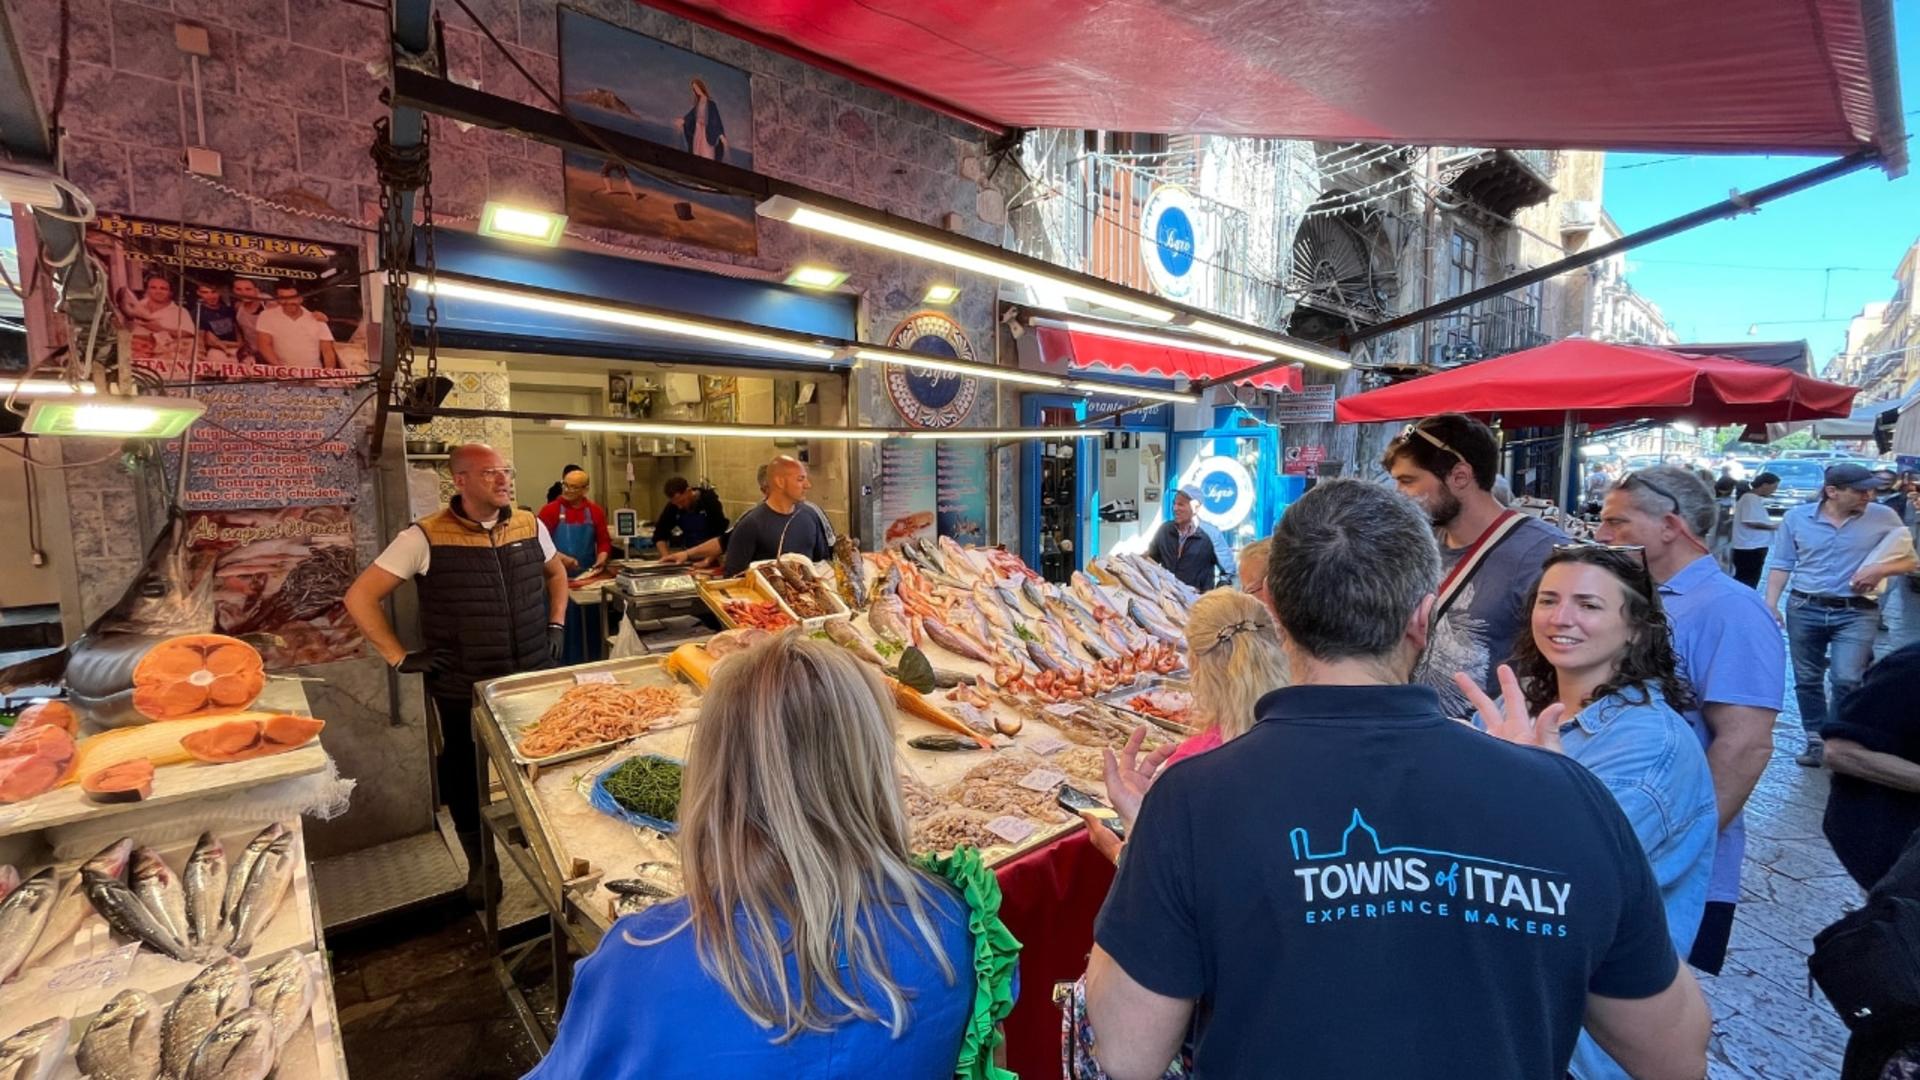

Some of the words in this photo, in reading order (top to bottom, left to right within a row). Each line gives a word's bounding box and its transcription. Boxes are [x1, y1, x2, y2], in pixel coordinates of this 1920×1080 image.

[101, 216, 328, 258] PESCHERIA
[252, 264, 318, 280] MIMMO
[221, 363, 247, 378] HA
[250, 429, 322, 441] pomodorini
[168, 442, 218, 452] sampi
[223, 441, 296, 452] gambeetto
[217, 453, 246, 464] nero
[251, 452, 263, 463] di
[267, 453, 308, 466] seppia
[187, 491, 220, 501] tutto
[247, 490, 270, 500] che
[1294, 857, 1430, 902] TOWNS
[1435, 862, 1459, 896] of
[1465, 866, 1571, 916] ITALY
[1305, 900, 1449, 924] EXPERIENCE
[1465, 910, 1567, 937] MAKERS
